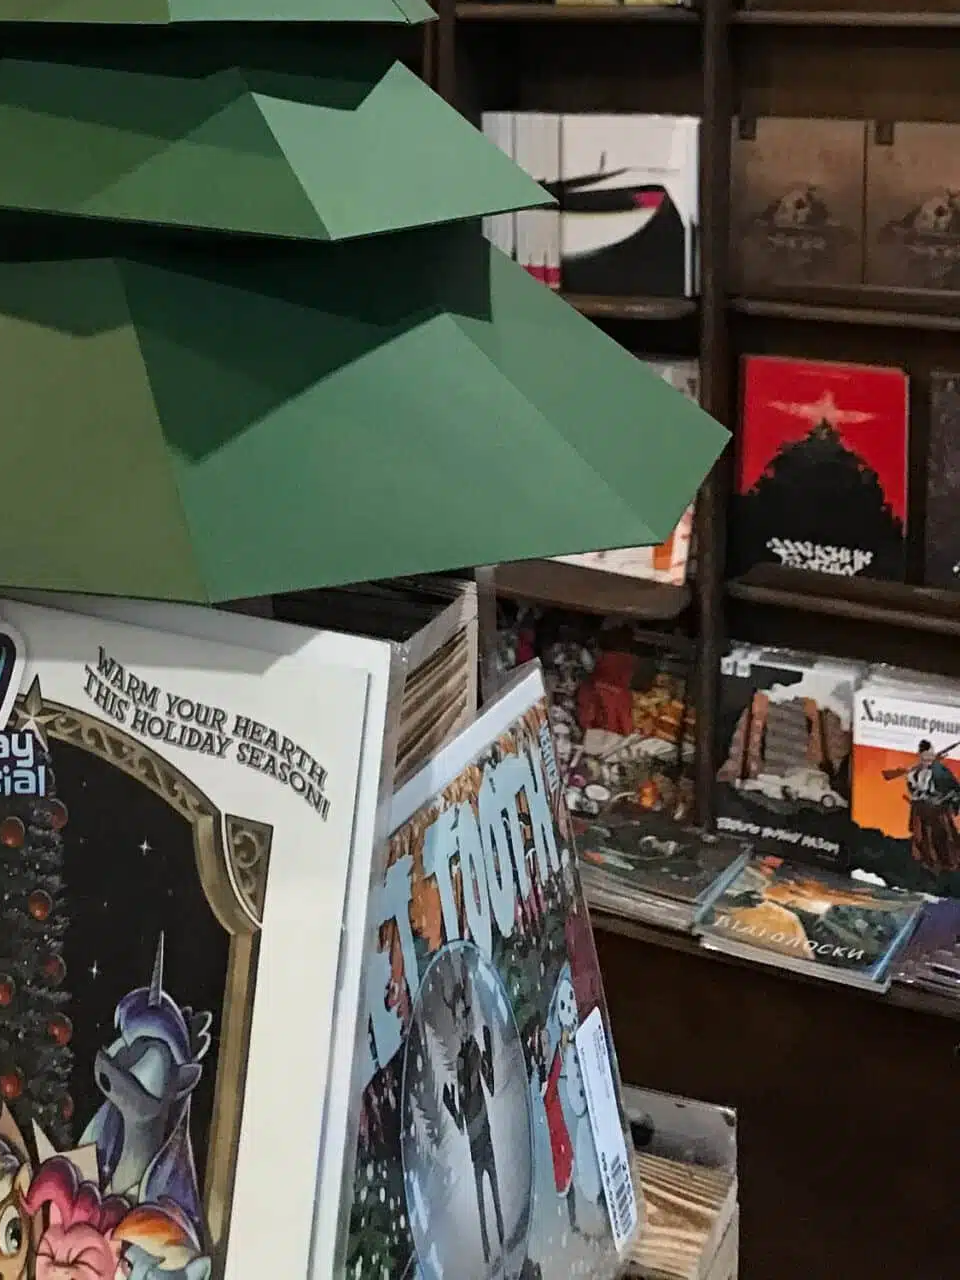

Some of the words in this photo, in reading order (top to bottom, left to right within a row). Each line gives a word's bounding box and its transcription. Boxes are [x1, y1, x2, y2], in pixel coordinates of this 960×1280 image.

[83, 664, 131, 723] THIS
[130, 707, 234, 759] HOLIDAY
[235, 741, 332, 822] SEASON!
[95, 645, 161, 711] WARM
[164, 691, 227, 734] YOUR
[231, 714, 329, 792] HEARTH
